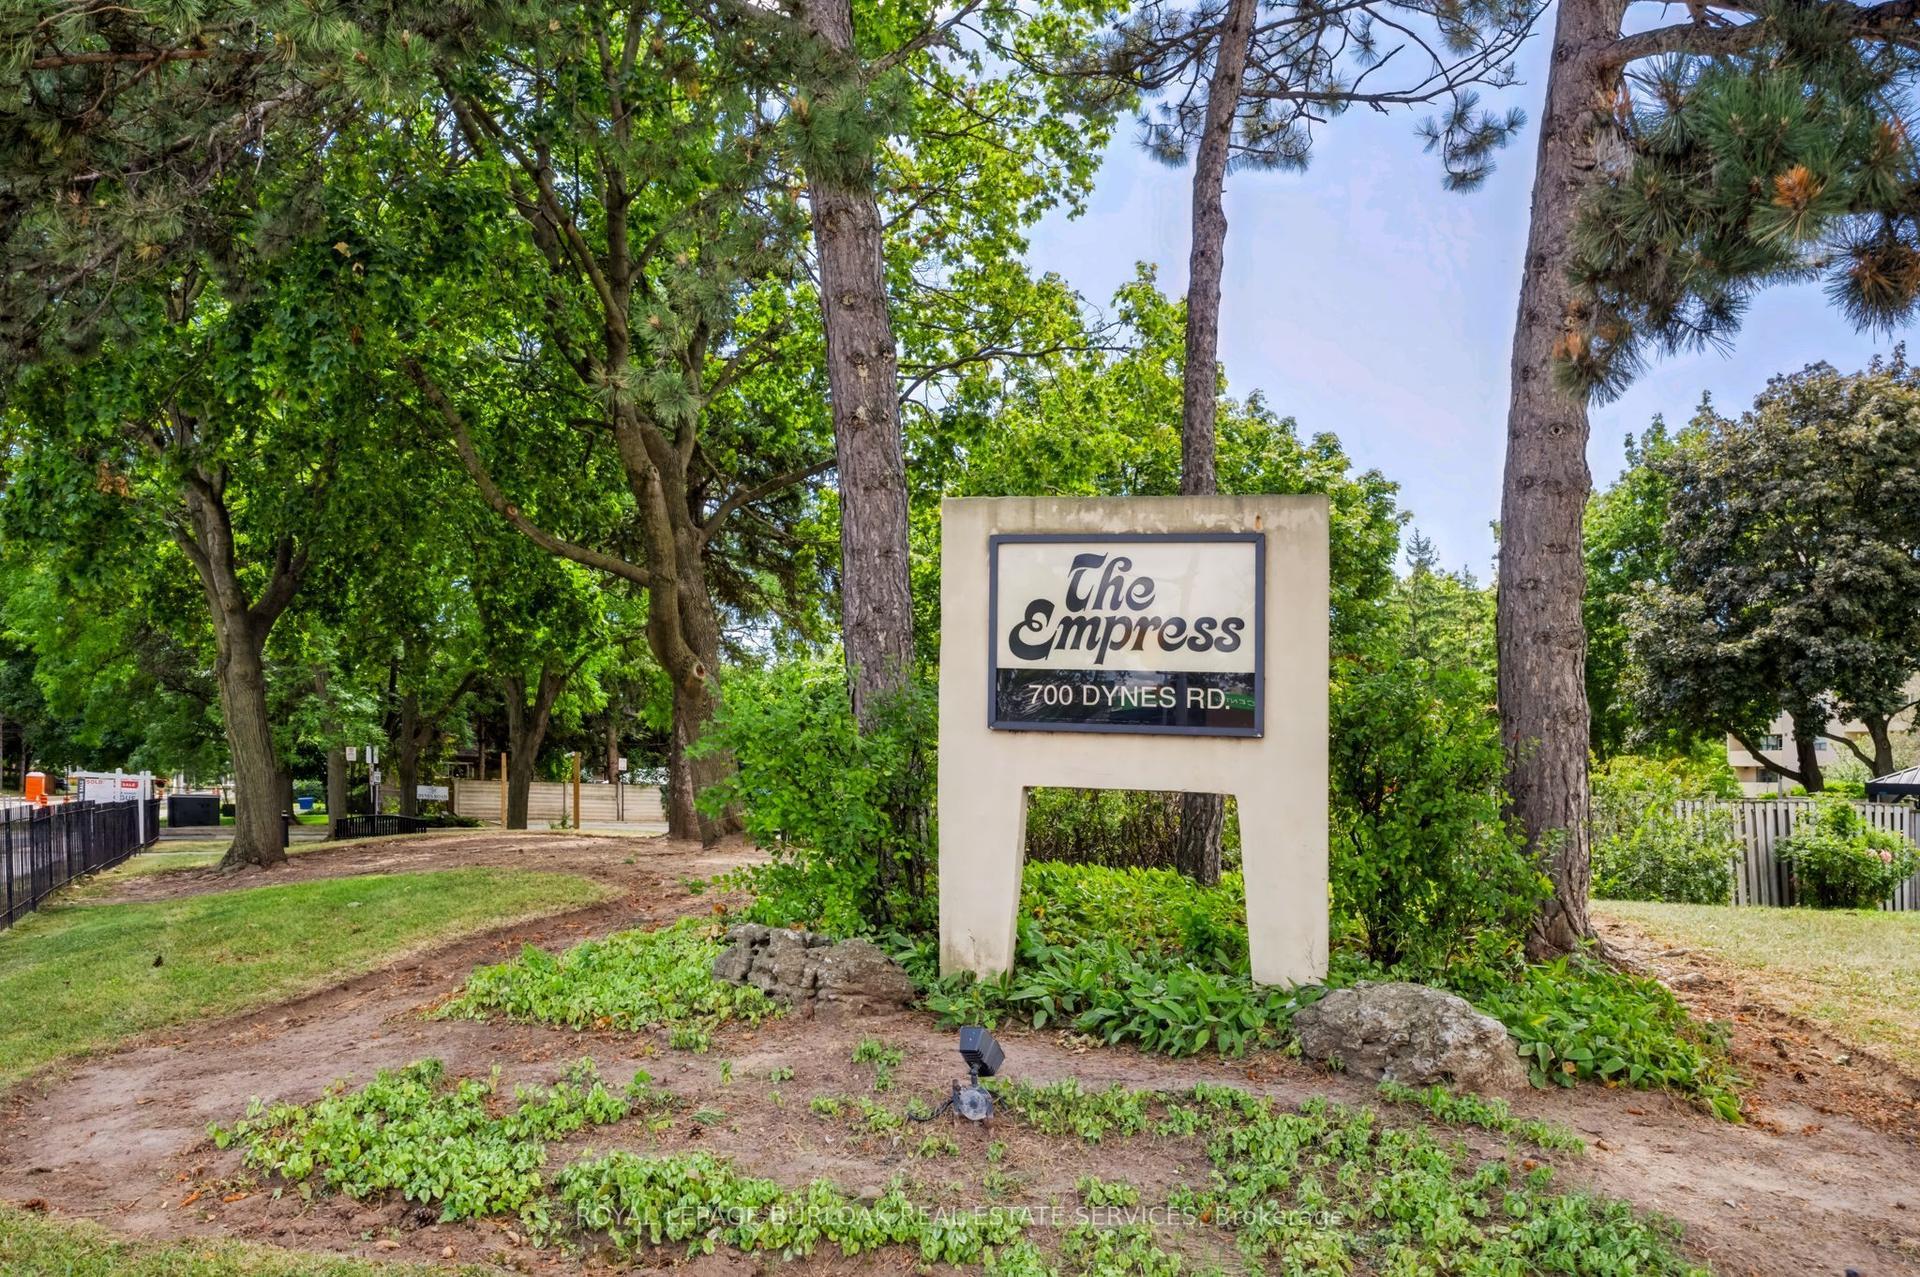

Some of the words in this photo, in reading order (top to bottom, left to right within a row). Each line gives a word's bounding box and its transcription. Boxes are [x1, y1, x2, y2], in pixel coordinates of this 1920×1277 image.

[1065, 552, 1155, 612] The
[1008, 598, 1245, 665] Empress
[1029, 684, 1073, 706] 700
[1083, 685, 1176, 709] DYNES
[1186, 687, 1231, 710] RD.
